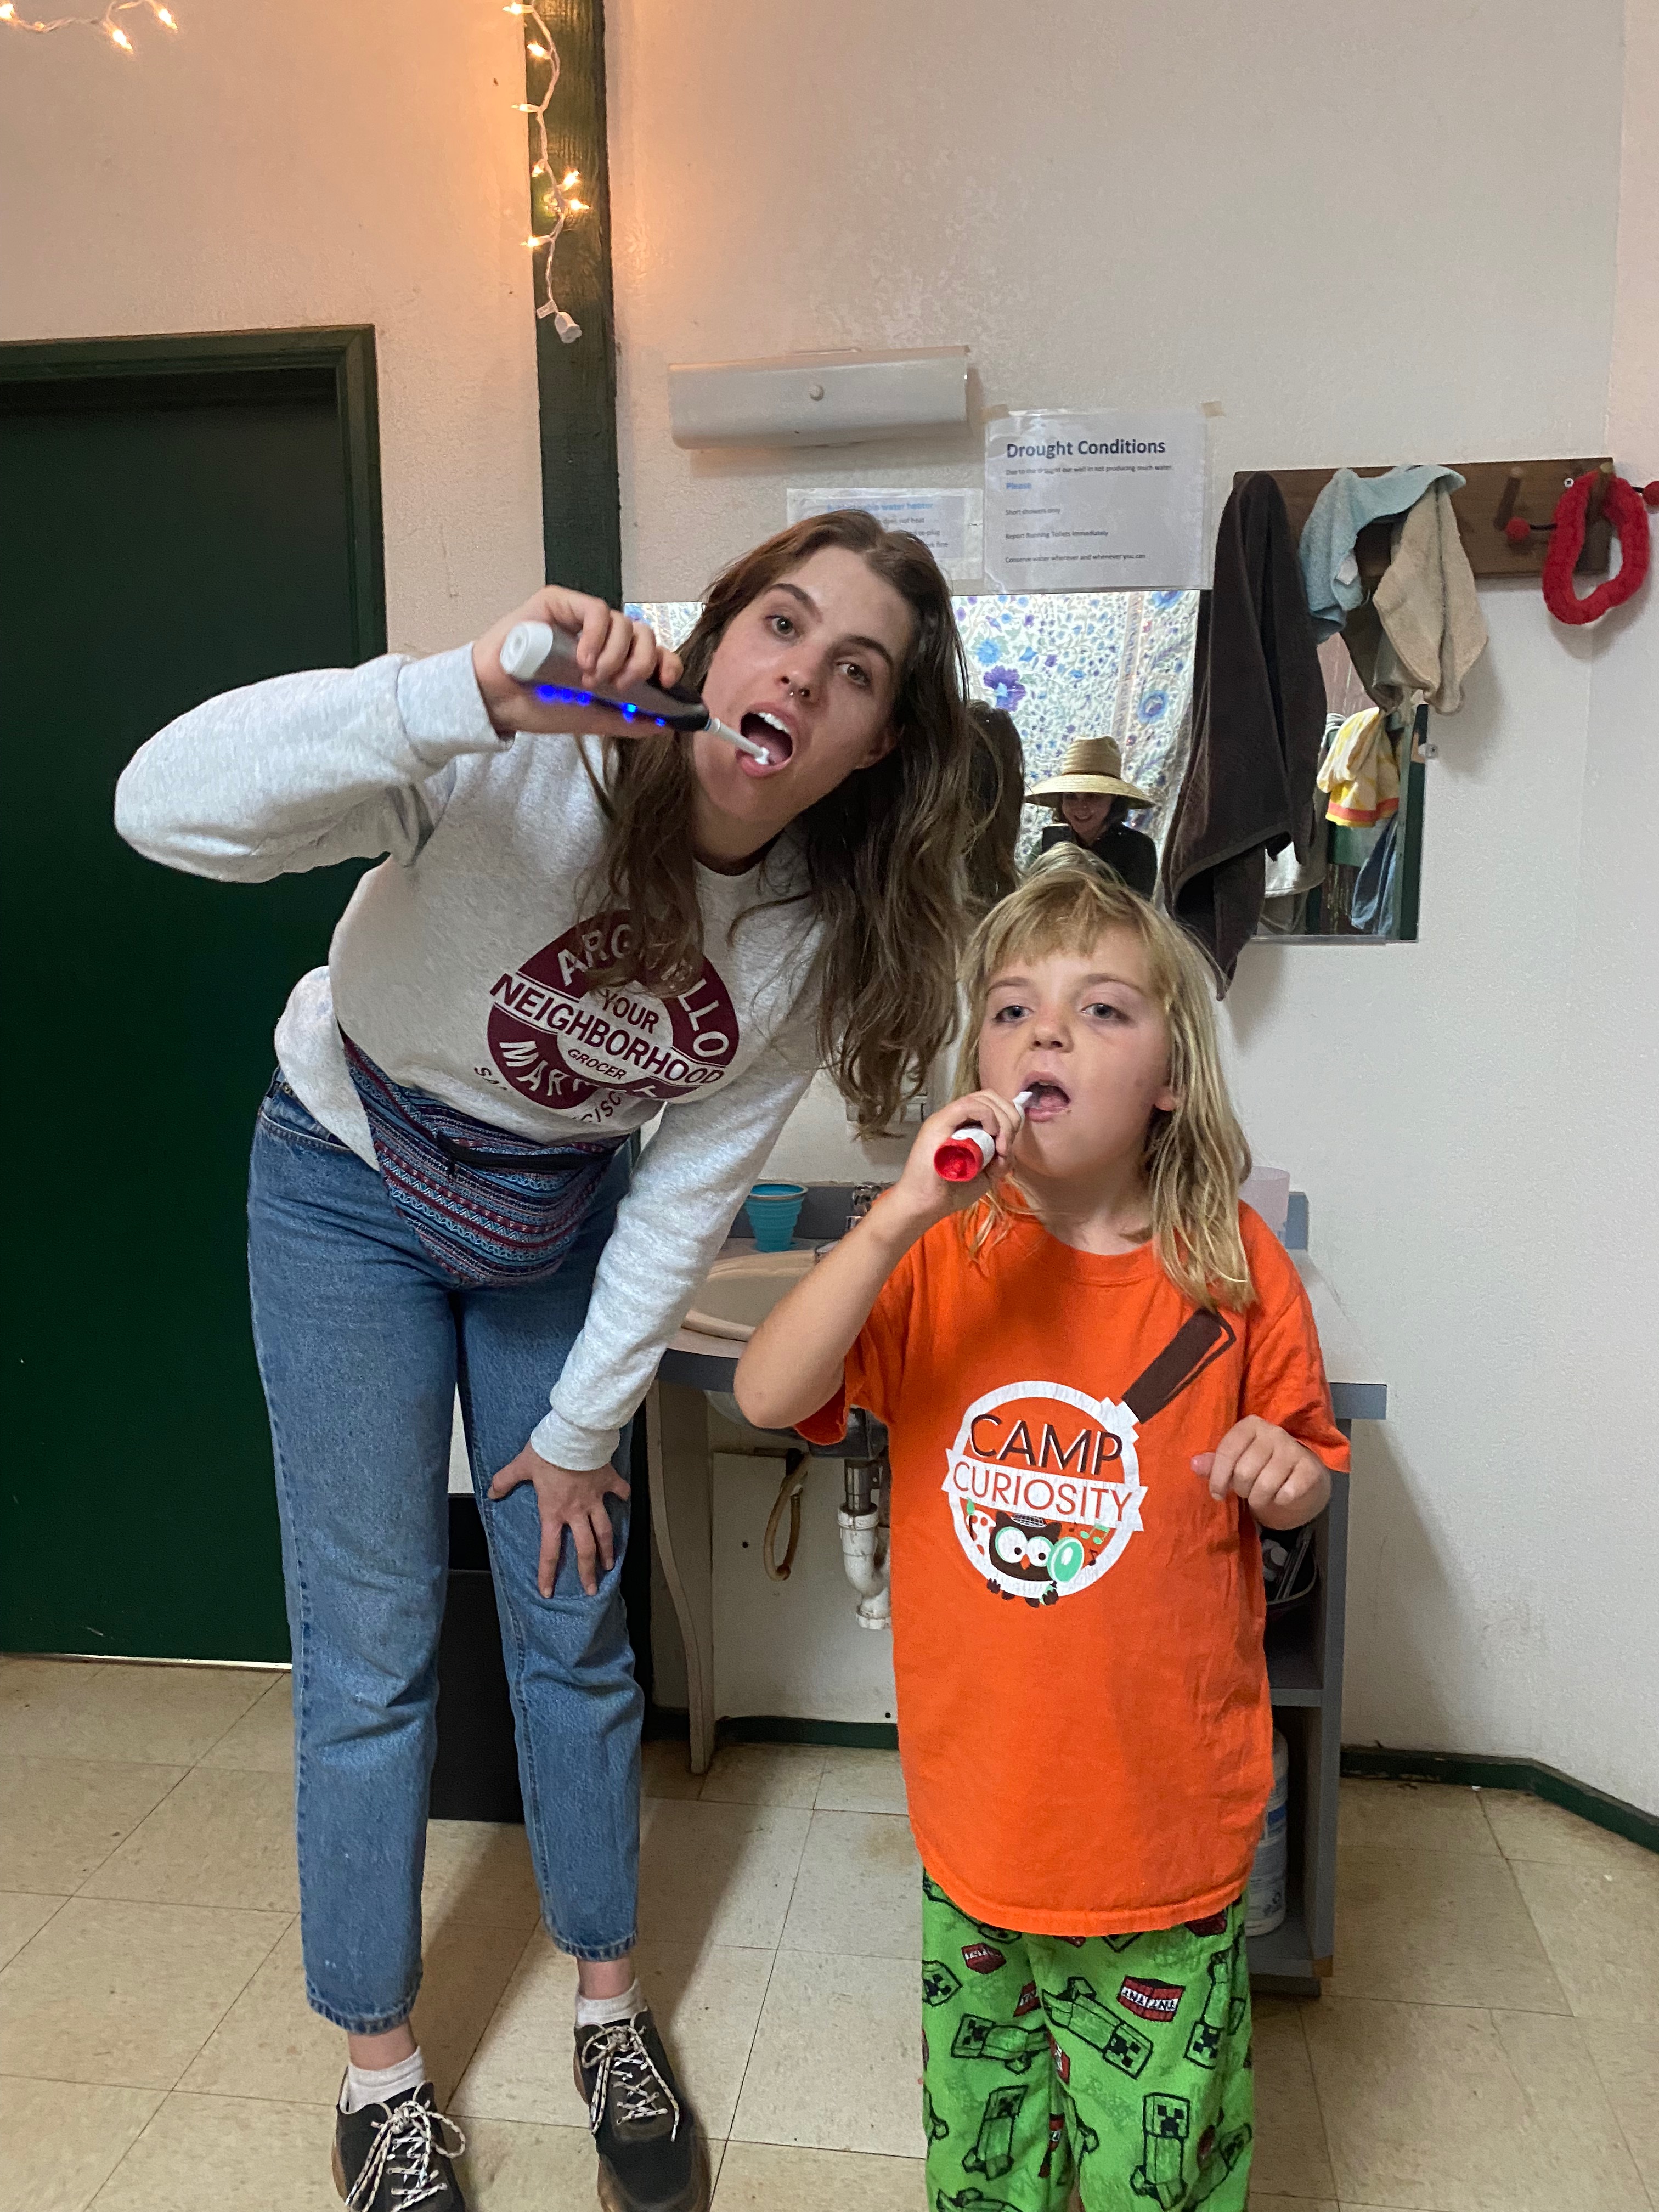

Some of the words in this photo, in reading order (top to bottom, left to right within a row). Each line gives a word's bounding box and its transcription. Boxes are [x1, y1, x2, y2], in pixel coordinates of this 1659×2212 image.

[1007, 441, 1073, 459] Drought
[1077, 438, 1166, 455] Conditions
[557, 923, 729, 1057] ARGLLO
[602, 989, 659, 1034] YOUR
[489, 973, 725, 1085] NEIGHBORHOOD
[499, 1040, 658, 1097] MART
[568, 1048, 628, 1081] GROCER
[969, 1413, 1123, 1476] CAMP
[953, 1461, 1133, 1522] CURIOSITY
